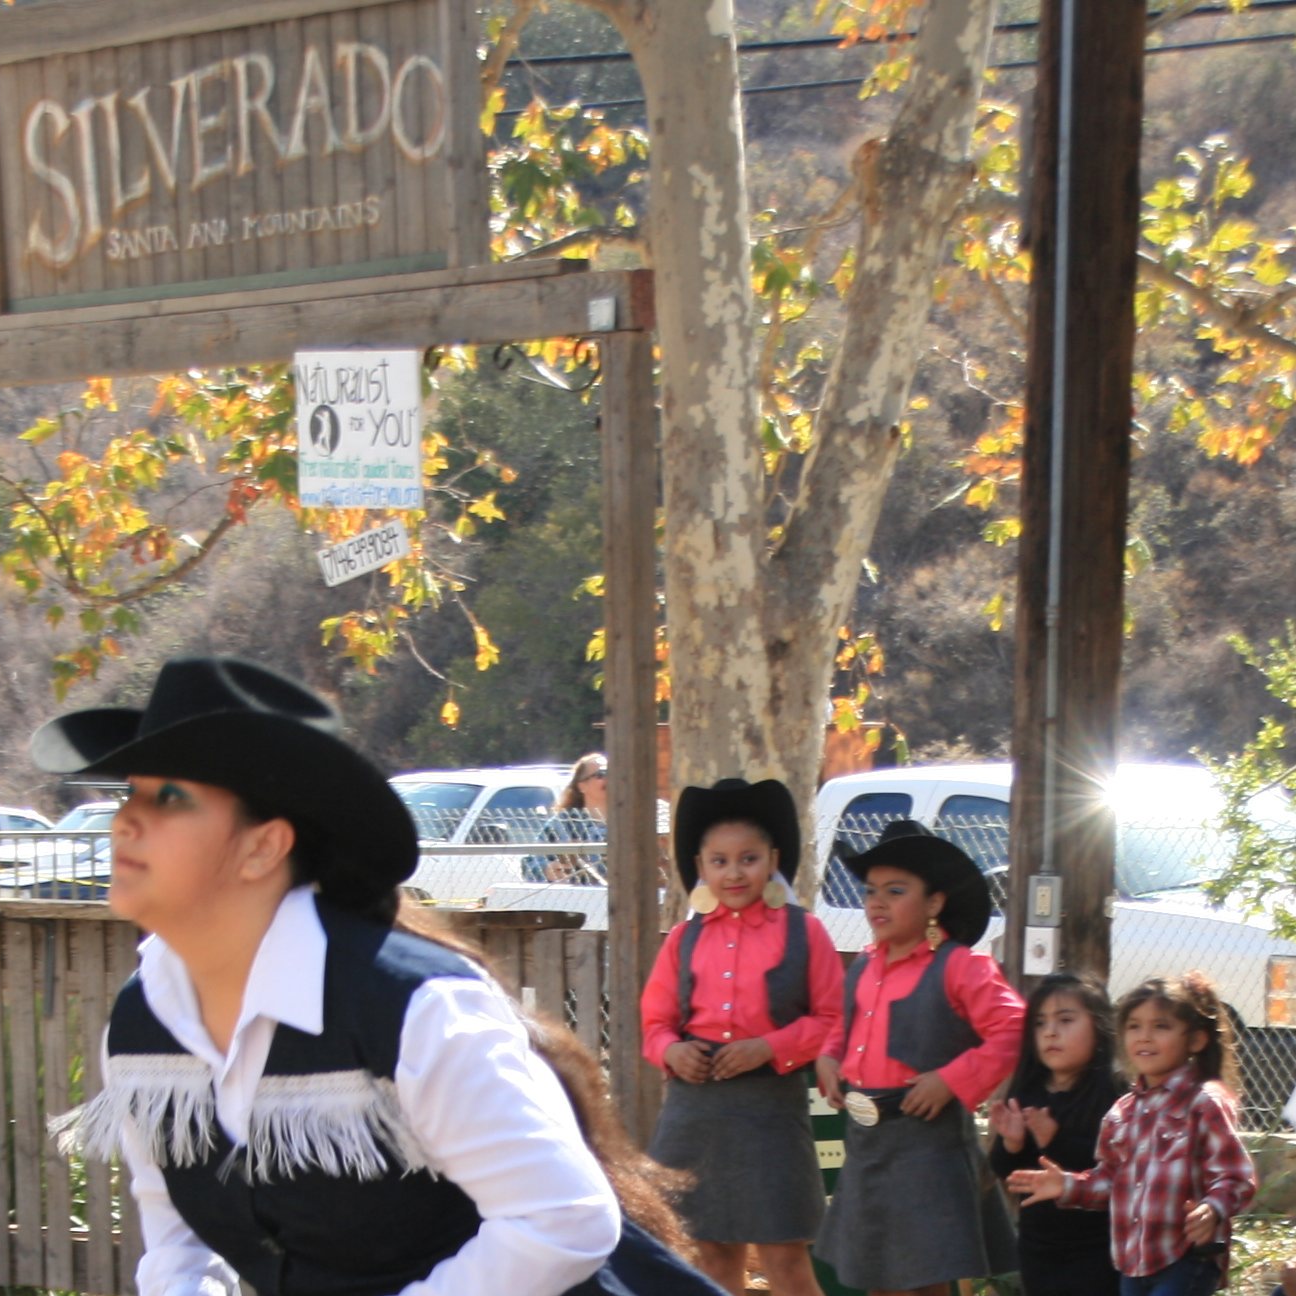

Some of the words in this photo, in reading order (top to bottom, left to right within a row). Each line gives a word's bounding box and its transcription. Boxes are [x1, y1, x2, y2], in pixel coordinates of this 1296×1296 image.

[24, 42, 446, 268] SILVERADO
[106, 224, 179, 261] SANTA
[241, 196, 381, 240] MOUNTAINS
